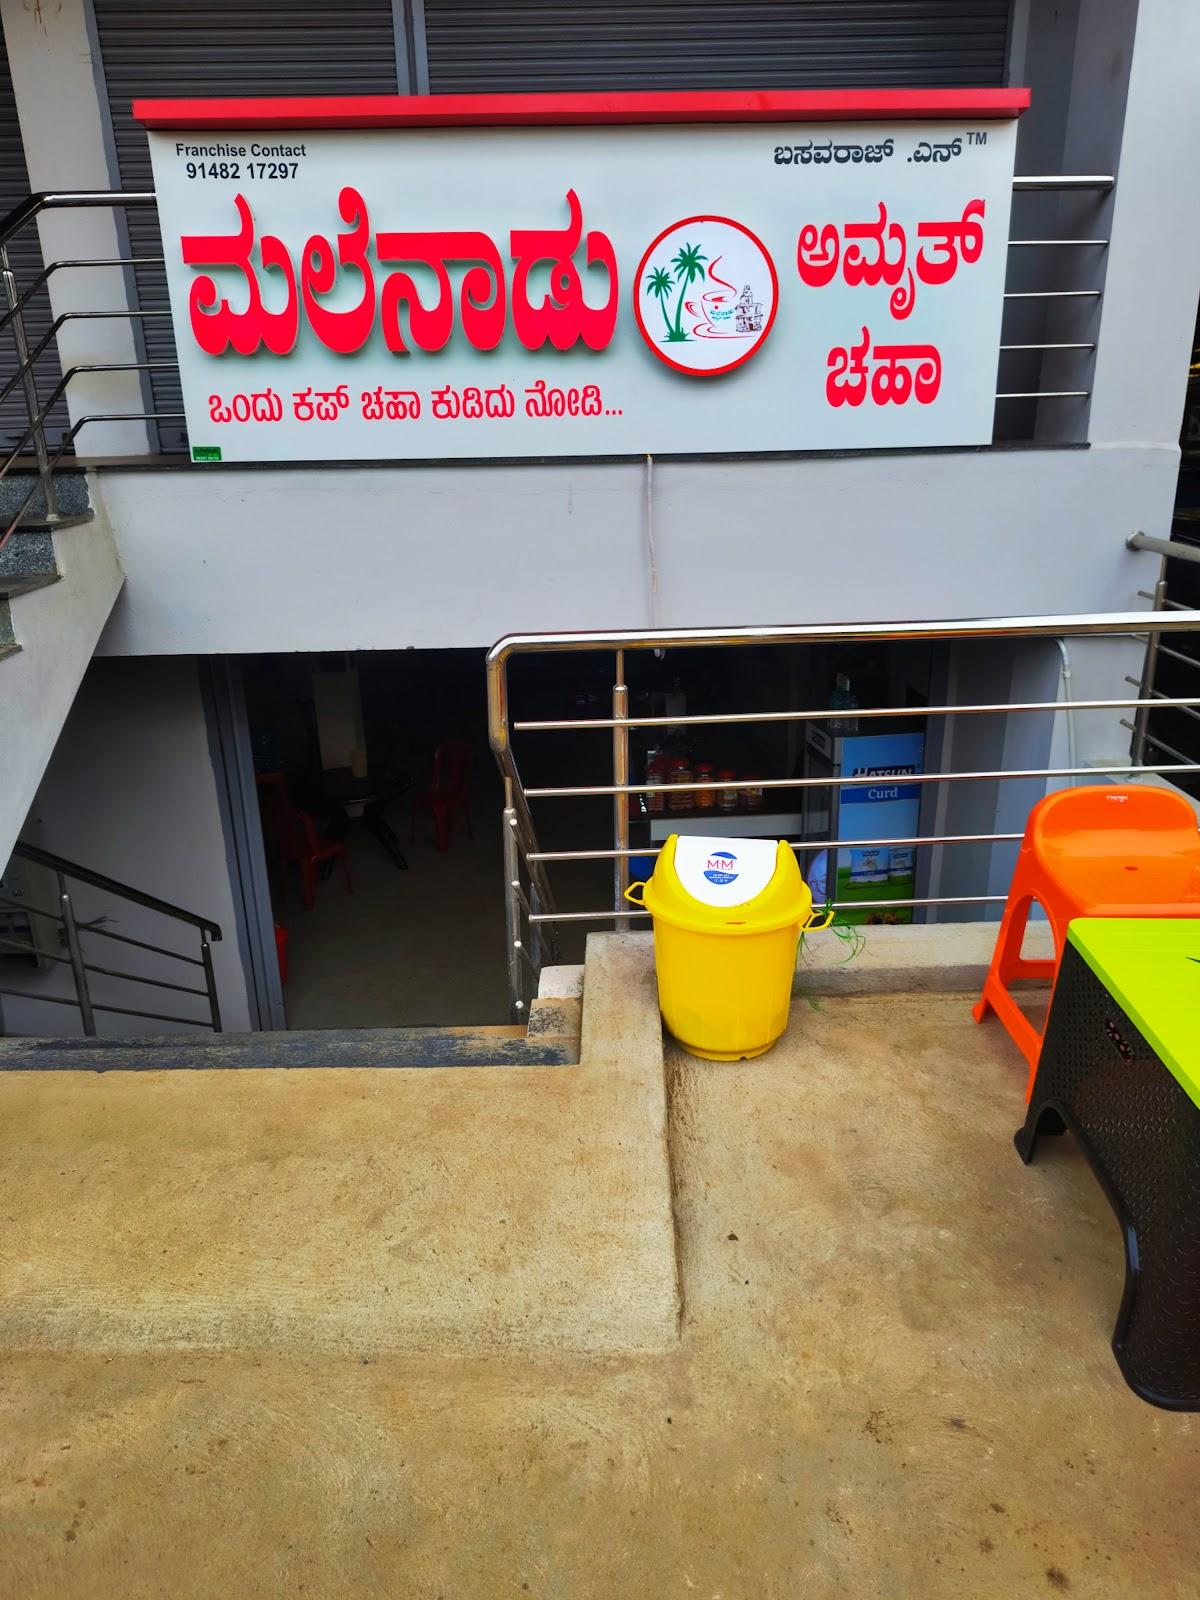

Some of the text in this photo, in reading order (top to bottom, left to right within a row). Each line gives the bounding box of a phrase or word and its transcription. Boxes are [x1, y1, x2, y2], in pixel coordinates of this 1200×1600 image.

[176, 143, 306, 157] Franchise Contact
[774, 138, 894, 165] ಬಸವರಾಜ್
[966, 132, 987, 145] TM
[186, 162, 298, 179] 91482 17297
[181, 187, 620, 356] ಮಲೆನಾಡು
[797, 199, 985, 320] ಅಮೃತ್
[826, 326, 941, 407] ಚಹಾ
[208, 387, 283, 422] ಒಂದು
[293, 384, 350, 421] ಕಪ್
[361, 386, 421, 420] ಚಹಾ
[431, 384, 515, 419] ಕುಡಿದು
[868, 787, 898, 800] Curd
